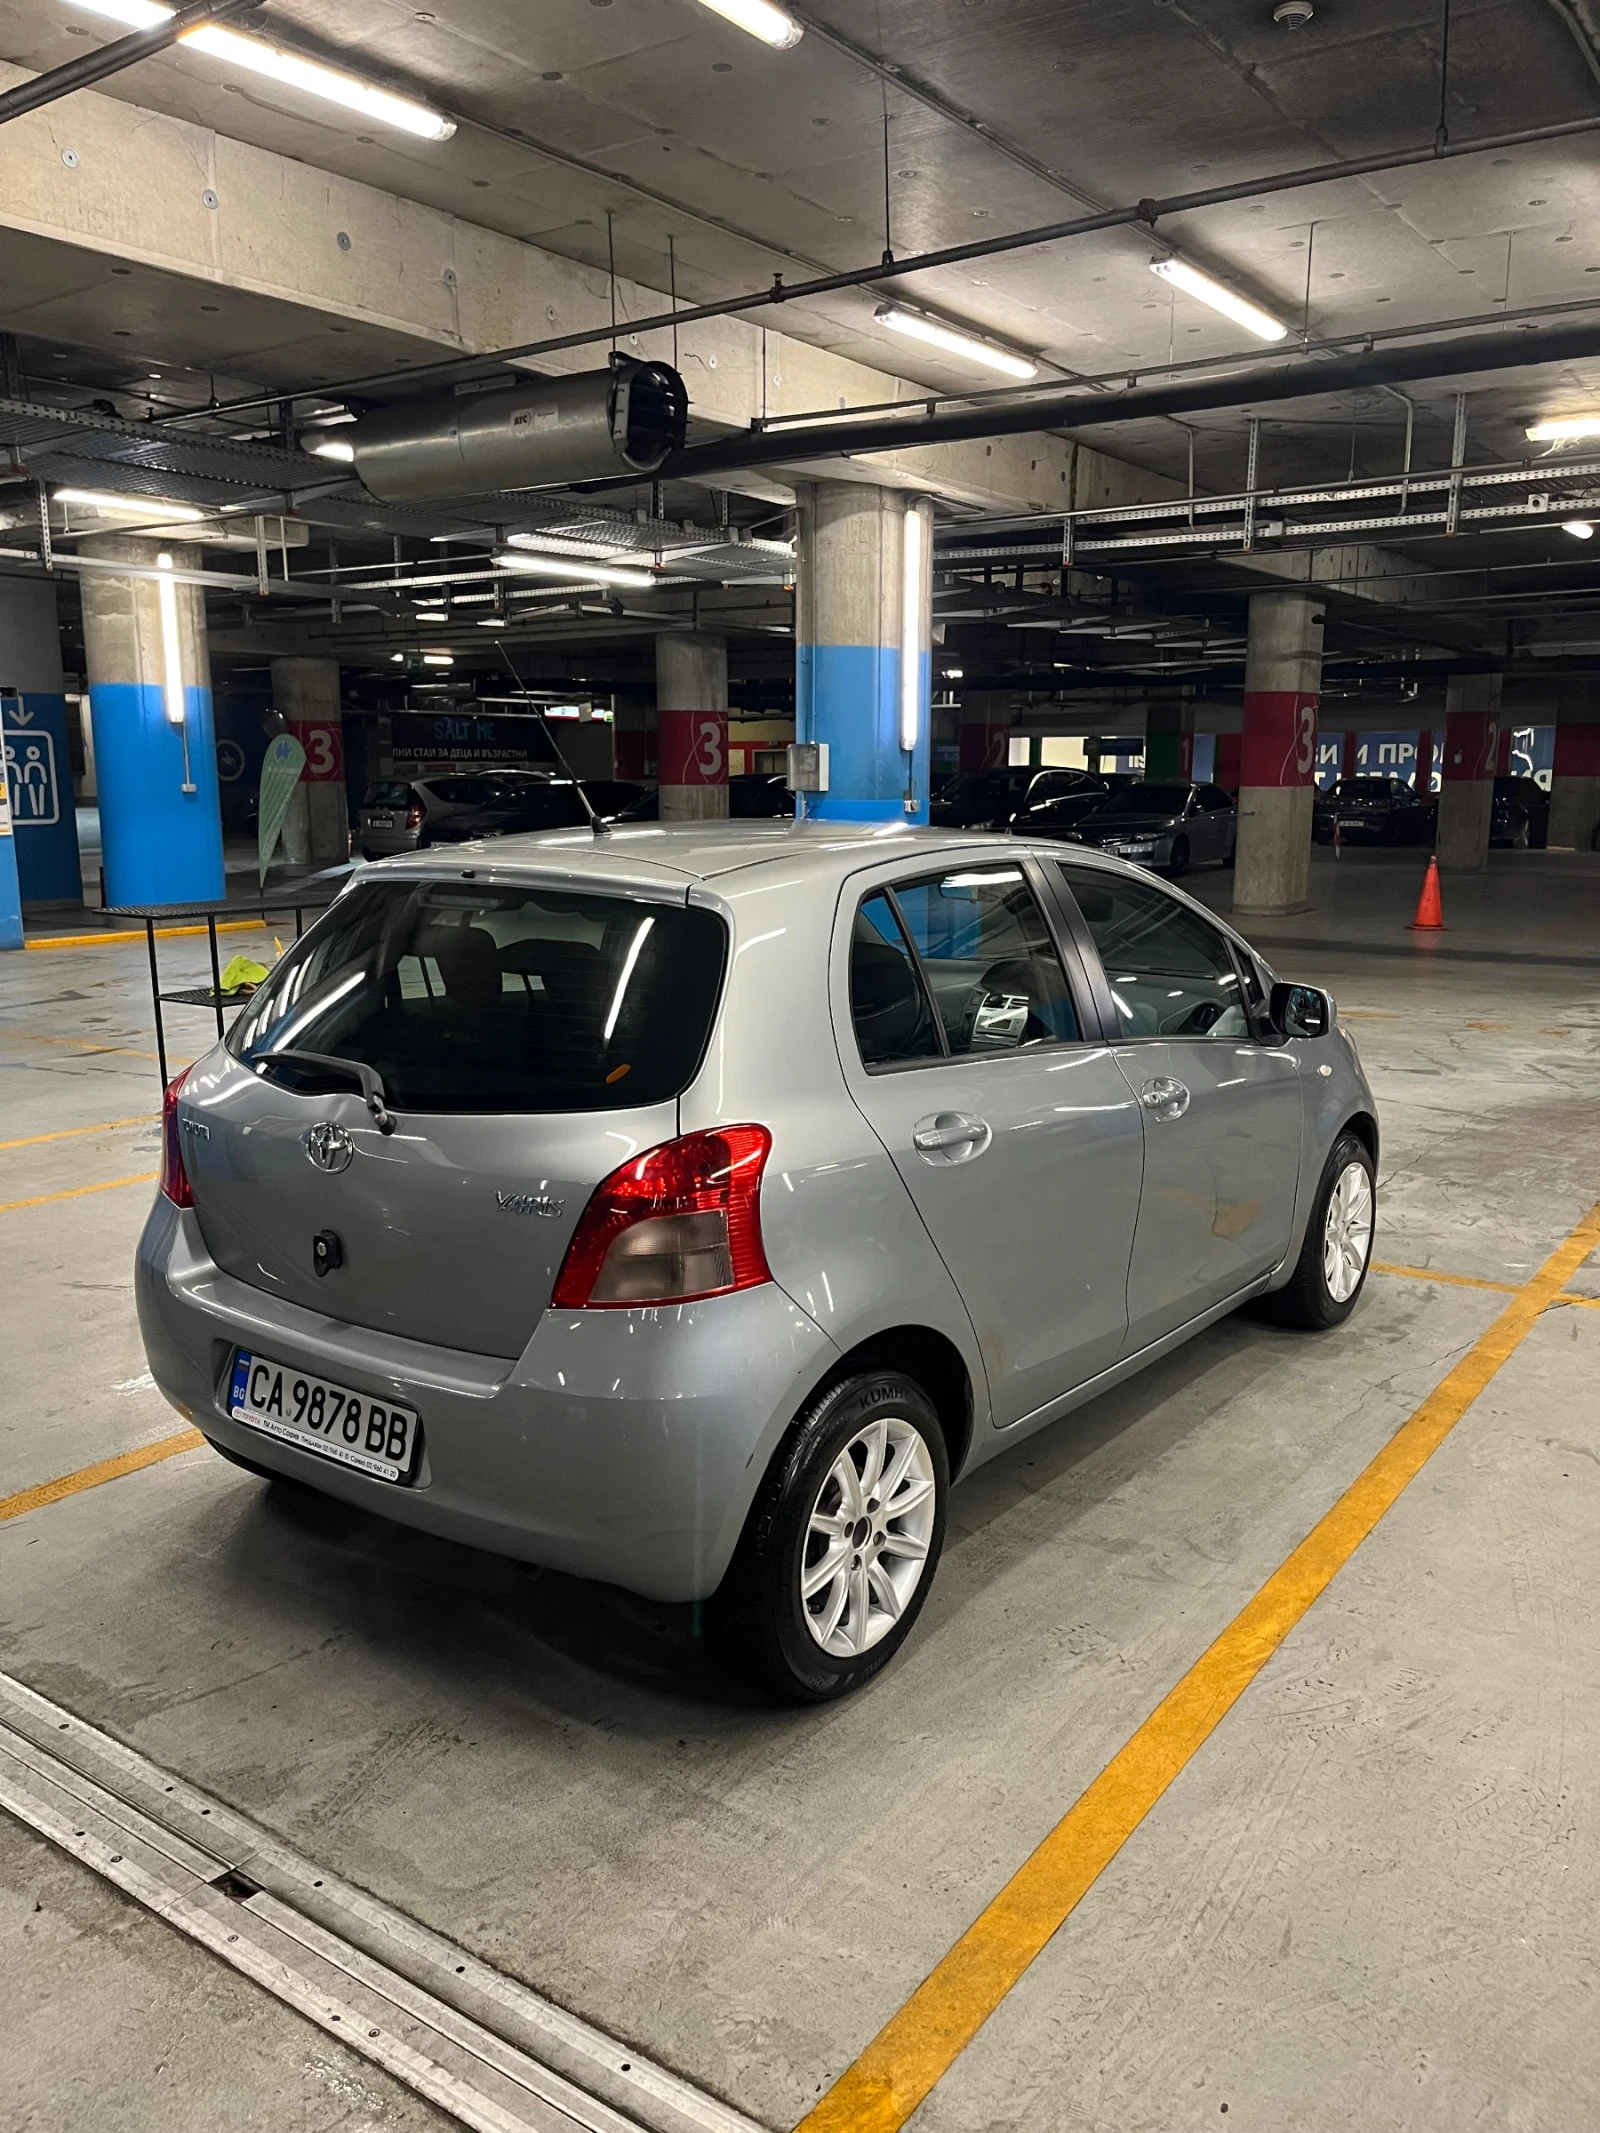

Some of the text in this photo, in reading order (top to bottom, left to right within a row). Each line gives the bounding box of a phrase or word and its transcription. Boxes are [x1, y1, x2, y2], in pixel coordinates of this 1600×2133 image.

[513, 415, 528, 426] ATC
[434, 716, 497, 741] SALT ME
[1297, 706, 1315, 774] 3
[309, 729, 335, 774] 3
[413, 748, 437, 758] СТАИ
[437, 748, 449, 758] ЗА
[450, 748, 473, 760] ДЕЦА
[473, 749, 480, 758] И
[700, 721, 723, 776] 3
[992, 731, 1008, 768] 2
[1182, 738, 1190, 771] 1
[1484, 721, 1497, 771] 2
[495, 1190, 565, 1217] YARIS
[233, 1385, 246, 1400] BG
[242, 1412, 260, 1424] TOYOTA
